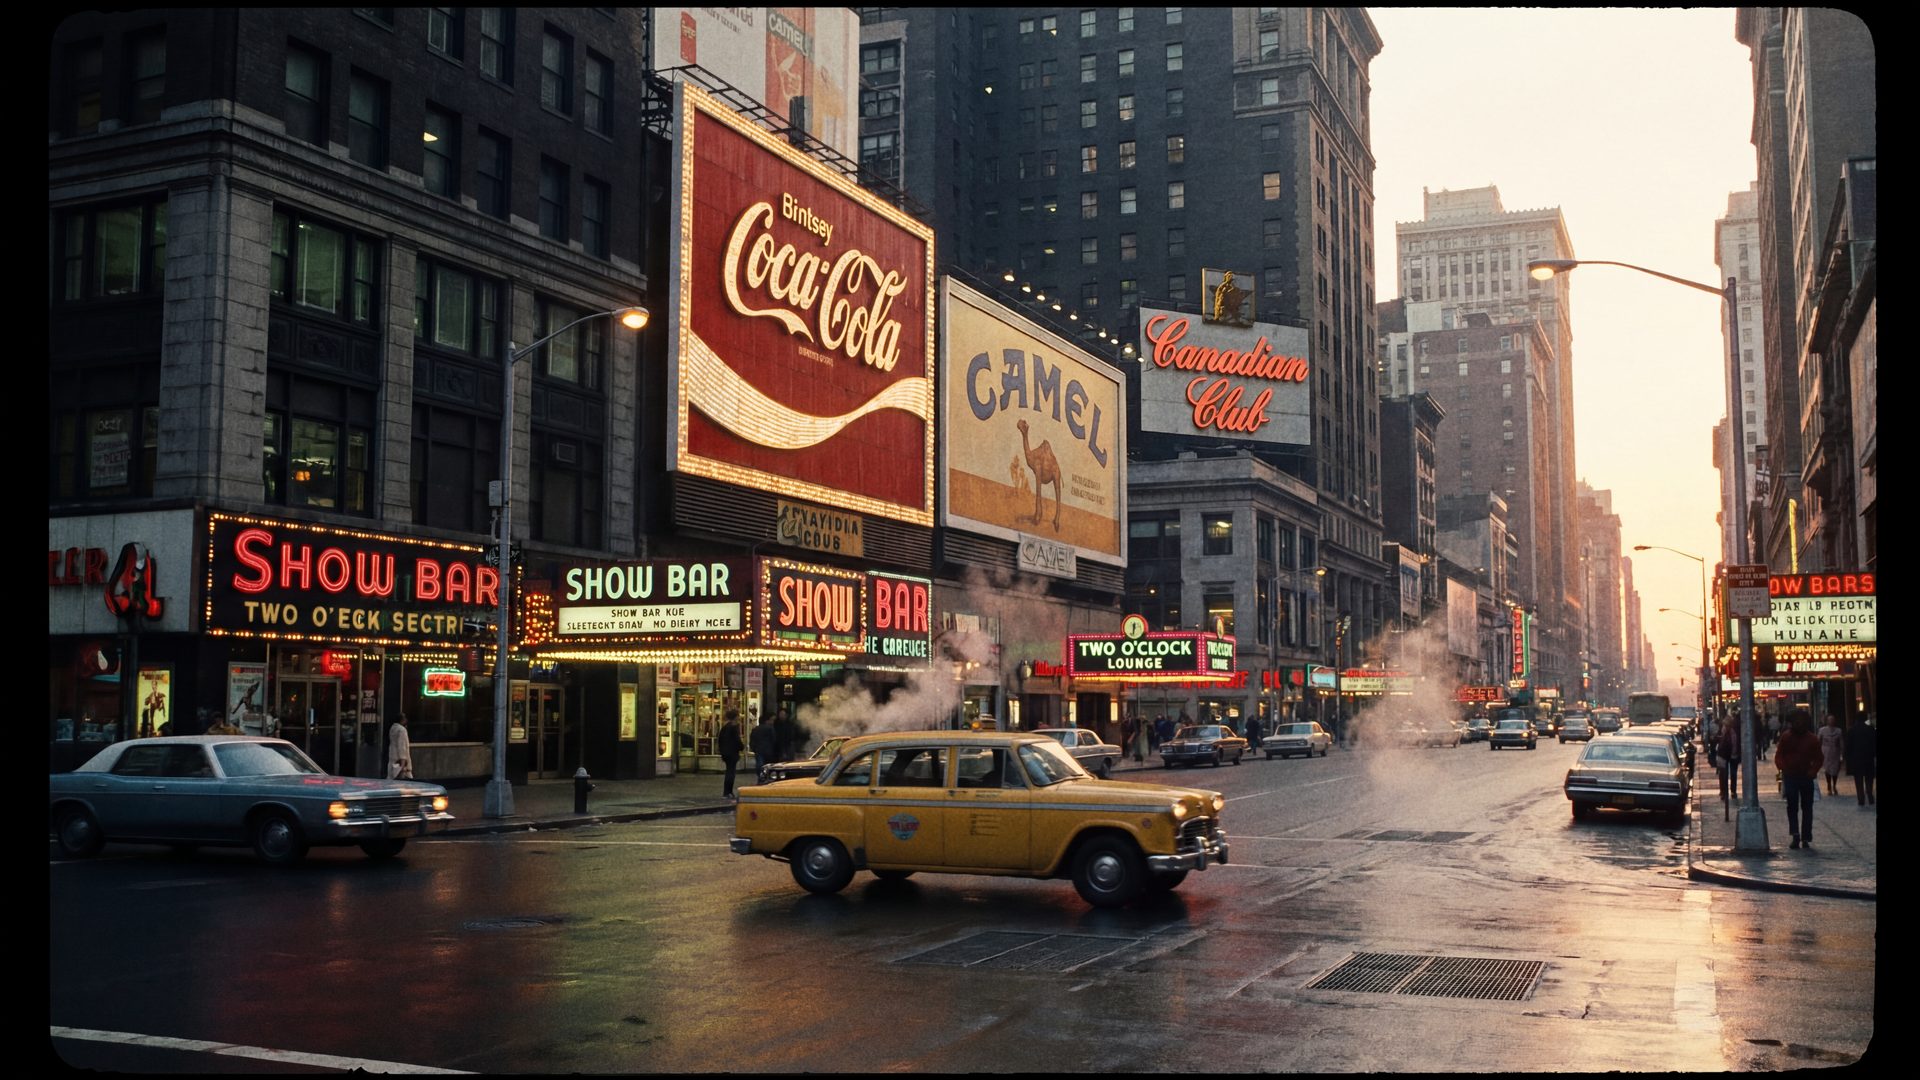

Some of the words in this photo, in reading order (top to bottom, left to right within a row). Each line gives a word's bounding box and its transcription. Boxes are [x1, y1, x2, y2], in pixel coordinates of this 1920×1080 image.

[768, 13, 809, 57] CAMEL
[782, 192, 833, 246] Bintsey
[1145, 314, 1310, 383] Canadian
[966, 348, 1108, 469] CAMEL
[1187, 376, 1274, 433] Club
[231, 527, 395, 596] SHOW
[415, 557, 500, 606] BAR
[566, 565, 652, 601] SHOW
[668, 563, 730, 598] BAR
[1810, 574, 1874, 594] BARS
[244, 601, 298, 625] TWO
[611, 608, 637, 618] SHOW
[642, 608, 661, 618] BAR
[779, 575, 853, 633] SHOW
[875, 579, 928, 633] BAR
[1079, 641, 1116, 657] TWO
[1121, 640, 1192, 656] O'CLOCK
[1774, 629, 1858, 641] HUNANE
[1107, 657, 1163, 670] LOUNGE
